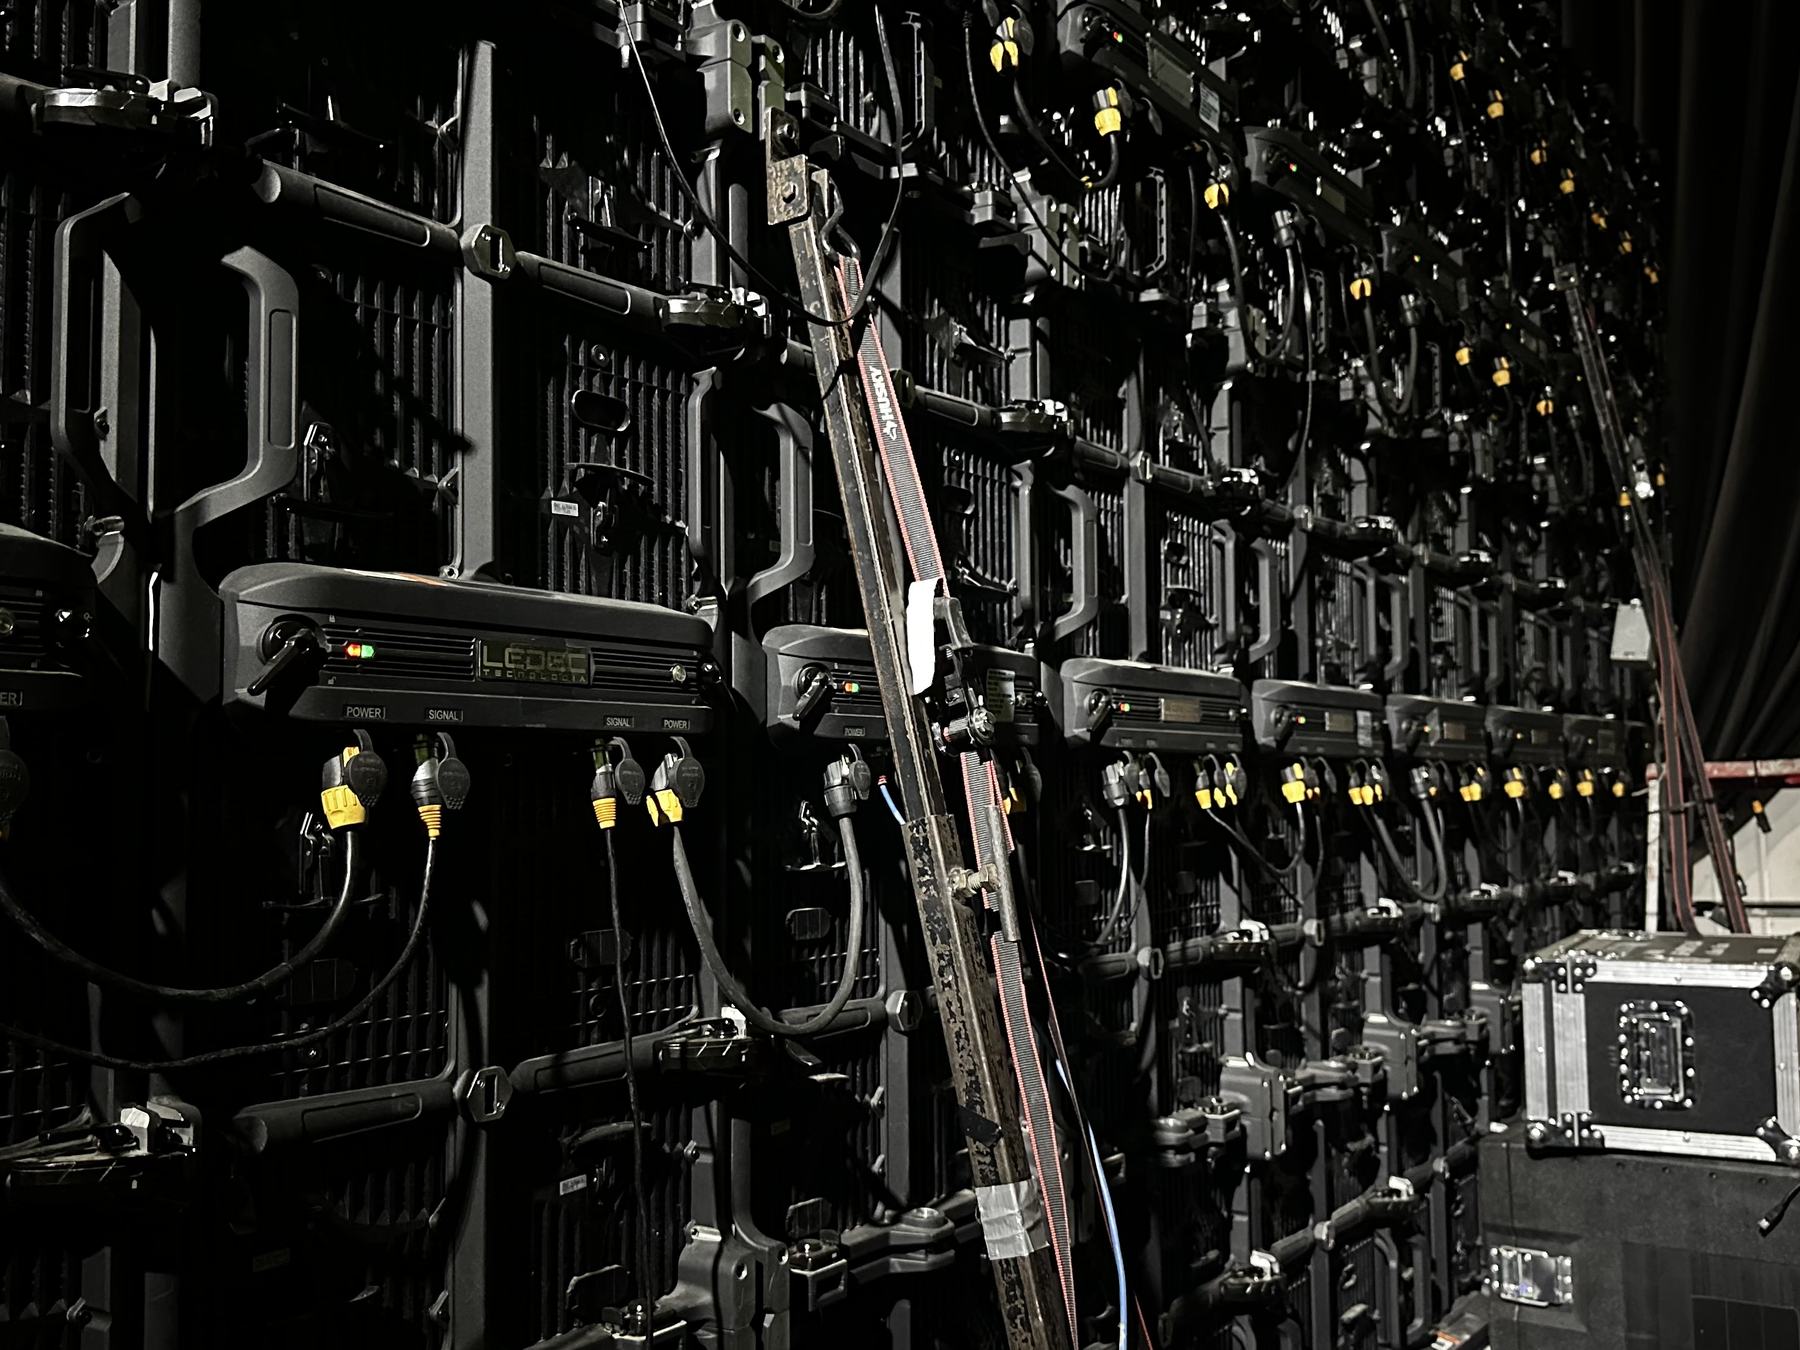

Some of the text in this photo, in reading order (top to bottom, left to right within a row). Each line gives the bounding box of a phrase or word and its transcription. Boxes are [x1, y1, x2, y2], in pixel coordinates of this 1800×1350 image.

[869, 365, 895, 421] HUSKY
[346, 706, 381, 718] POWER
[428, 709, 459, 720] SIGNAL
[606, 716, 631, 727] SIGNAL
[663, 719, 688, 729] POWER
